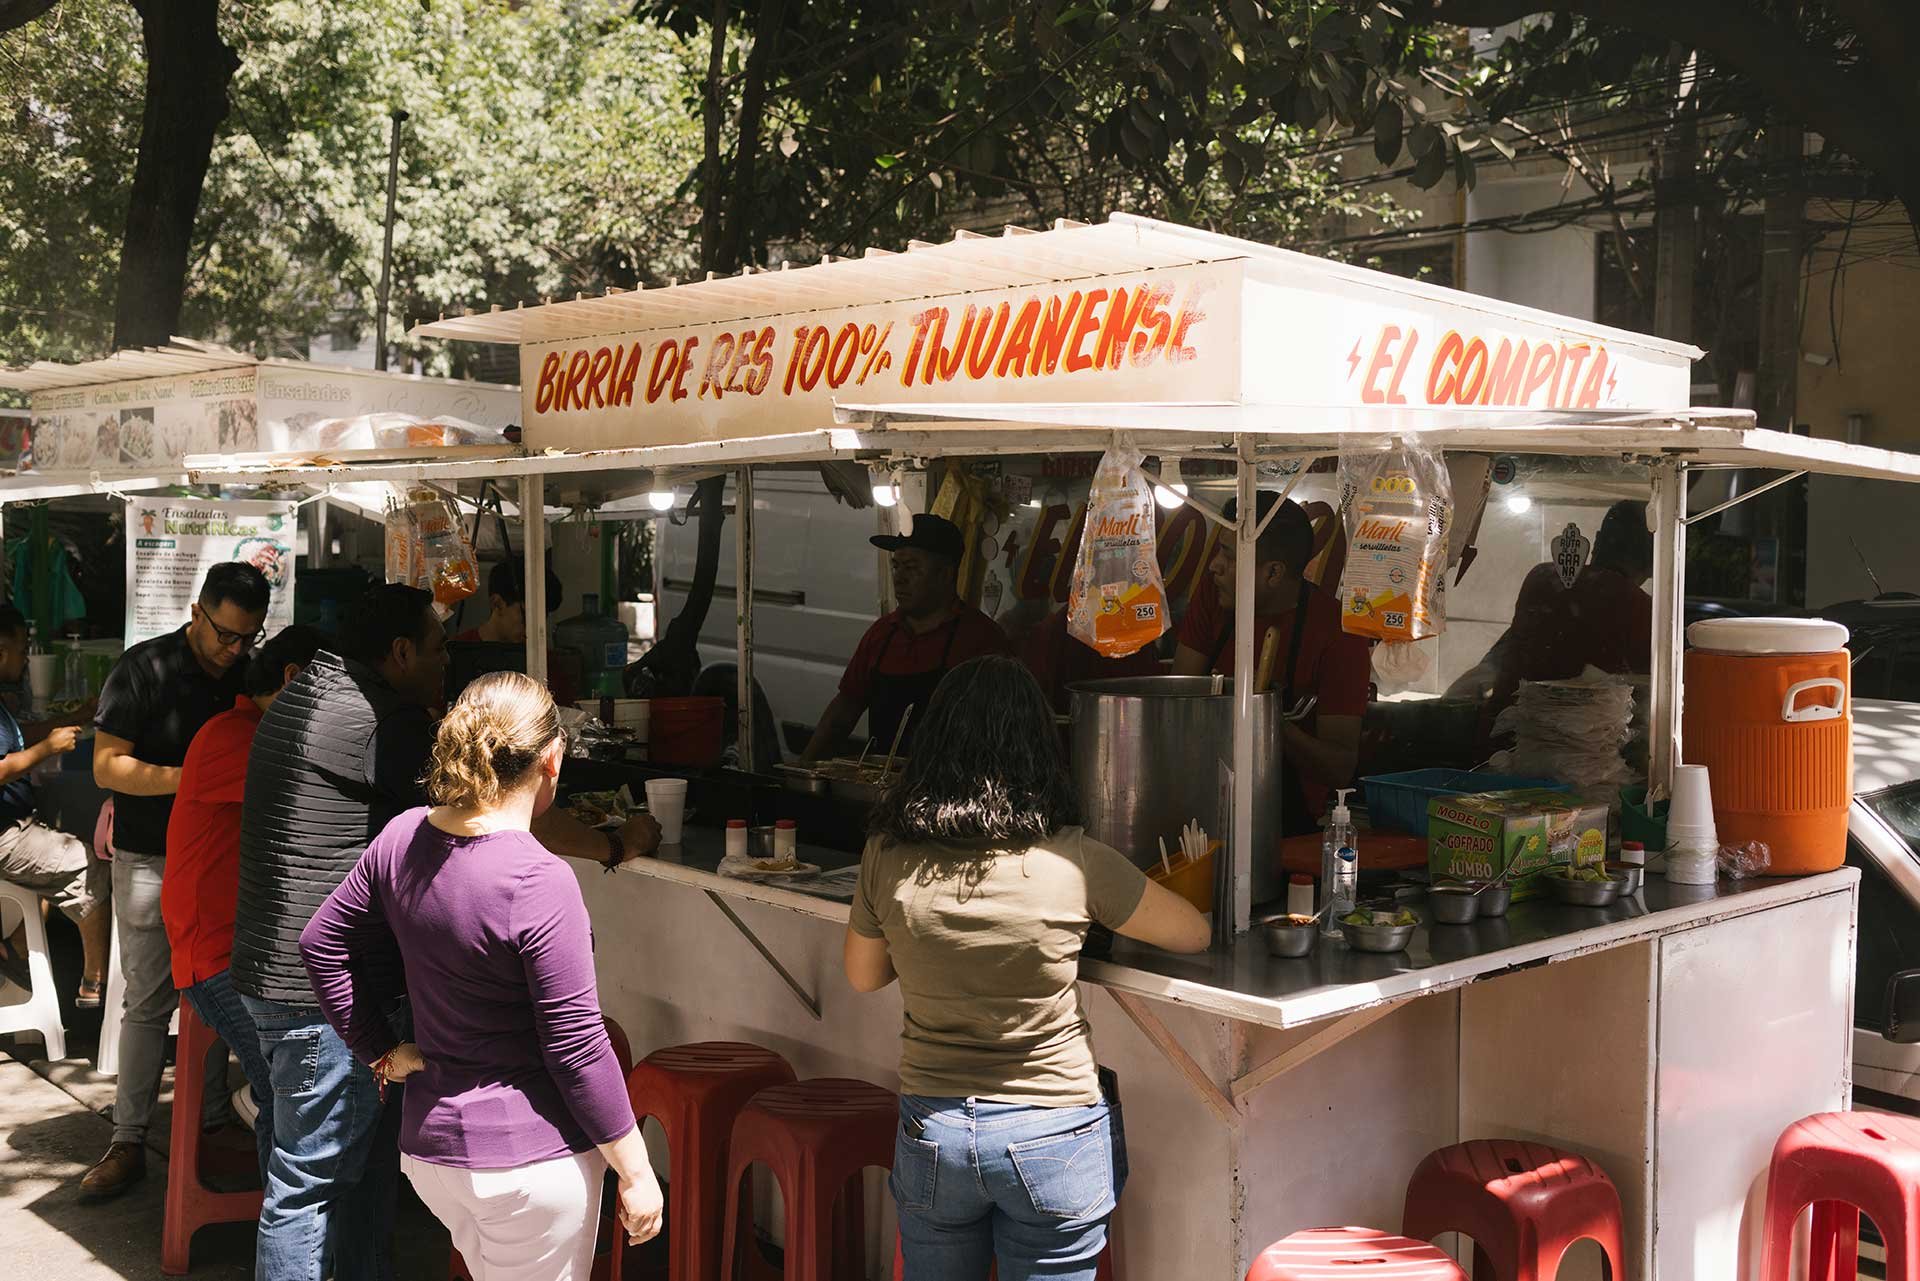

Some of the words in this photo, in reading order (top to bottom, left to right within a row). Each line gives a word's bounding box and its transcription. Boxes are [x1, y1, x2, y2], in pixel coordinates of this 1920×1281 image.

[645, 335, 700, 406] DE
[697, 325, 776, 401] RES
[782, 320, 895, 397] 100%
[900, 277, 1217, 389] TIJUANENSE
[1360, 323, 1419, 405] EL
[1424, 328, 1609, 409] COMPITA
[263, 379, 350, 402] Ensaladas
[162, 507, 228, 520] Ensaladas
[1098, 513, 1141, 536] Marli
[1355, 519, 1408, 543] Marli
[1560, 539, 1581, 549] RUTA
[1565, 530, 1576, 539] LA
[1359, 543, 1401, 552] servilletas
[1562, 566, 1576, 577] NA
[1136, 606, 1154, 617] 250
[1386, 614, 1404, 625] 250
[1437, 805, 1490, 830] MODELO
[1447, 834, 1495, 854] GOFRADO
[1448, 860, 1493, 879] JUMBO
